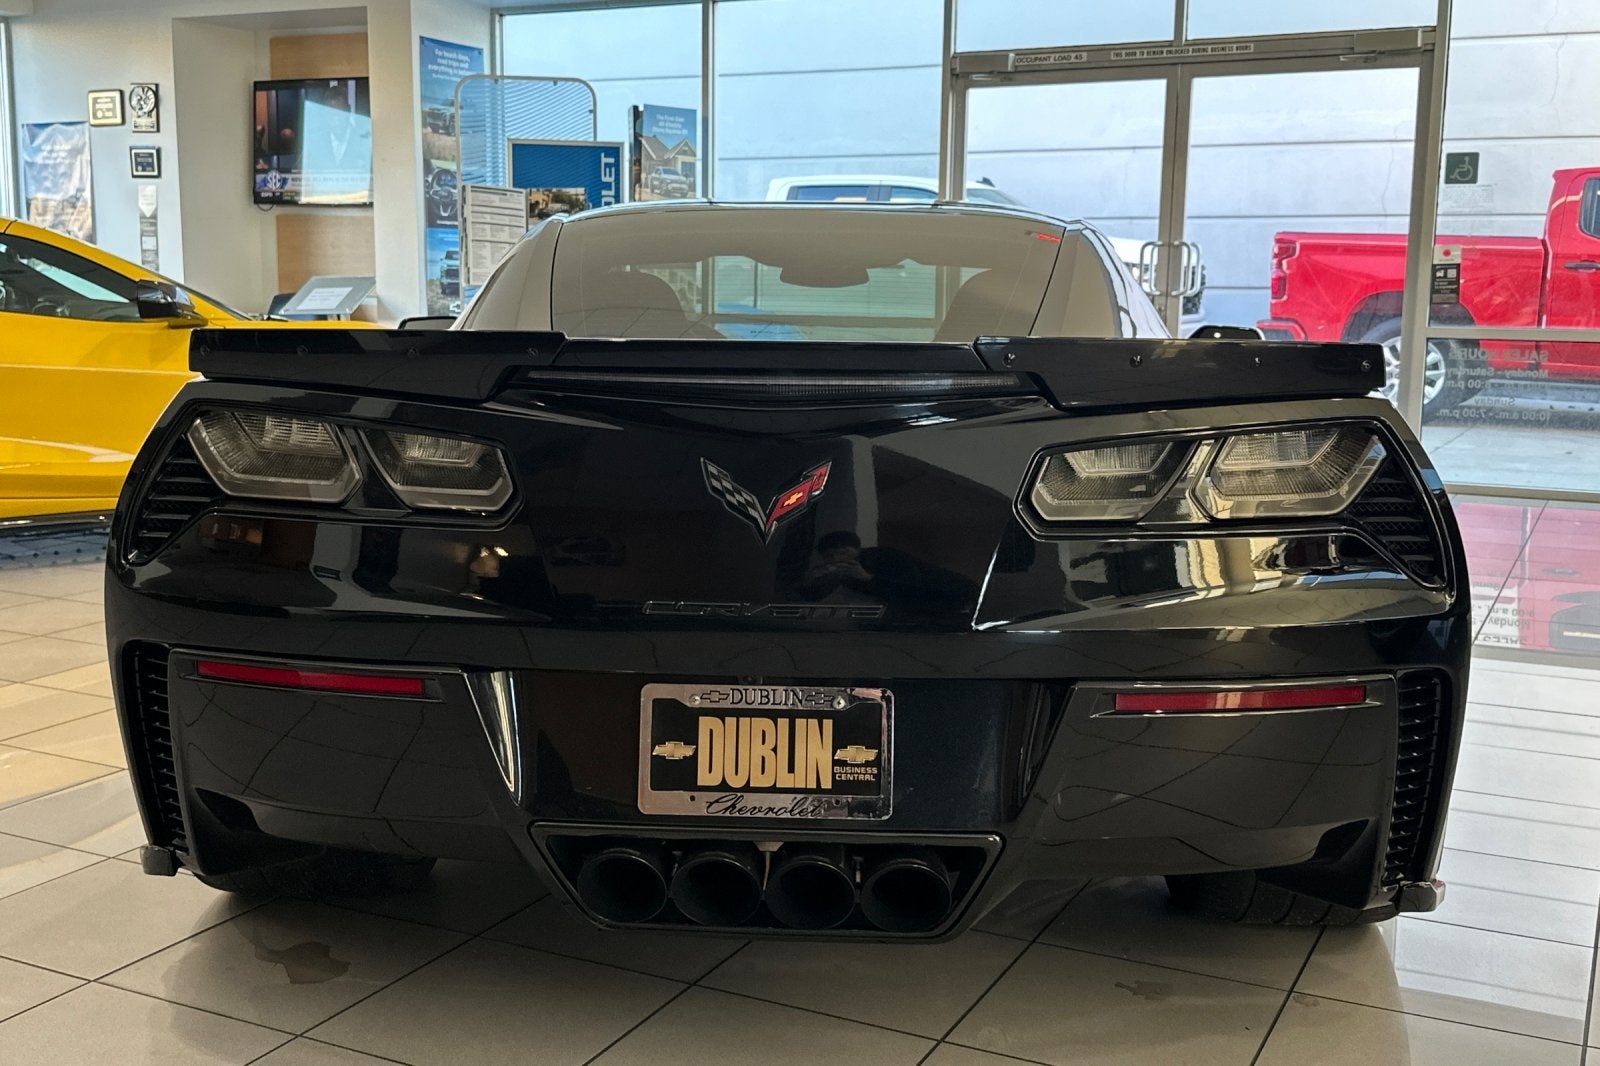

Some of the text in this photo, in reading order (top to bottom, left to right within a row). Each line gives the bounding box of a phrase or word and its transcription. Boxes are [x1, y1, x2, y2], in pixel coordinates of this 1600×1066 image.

[1016, 56, 1052, 64] OCCUPANT
[642, 600, 887, 618] CORVETTE
[730, 688, 804, 707] DUBLIN
[697, 716, 832, 789] DUBLIN
[834, 766, 878, 774] BUSINESS
[836, 774, 876, 782] CENTRAL
[705, 793, 824, 818] Chevrolet
